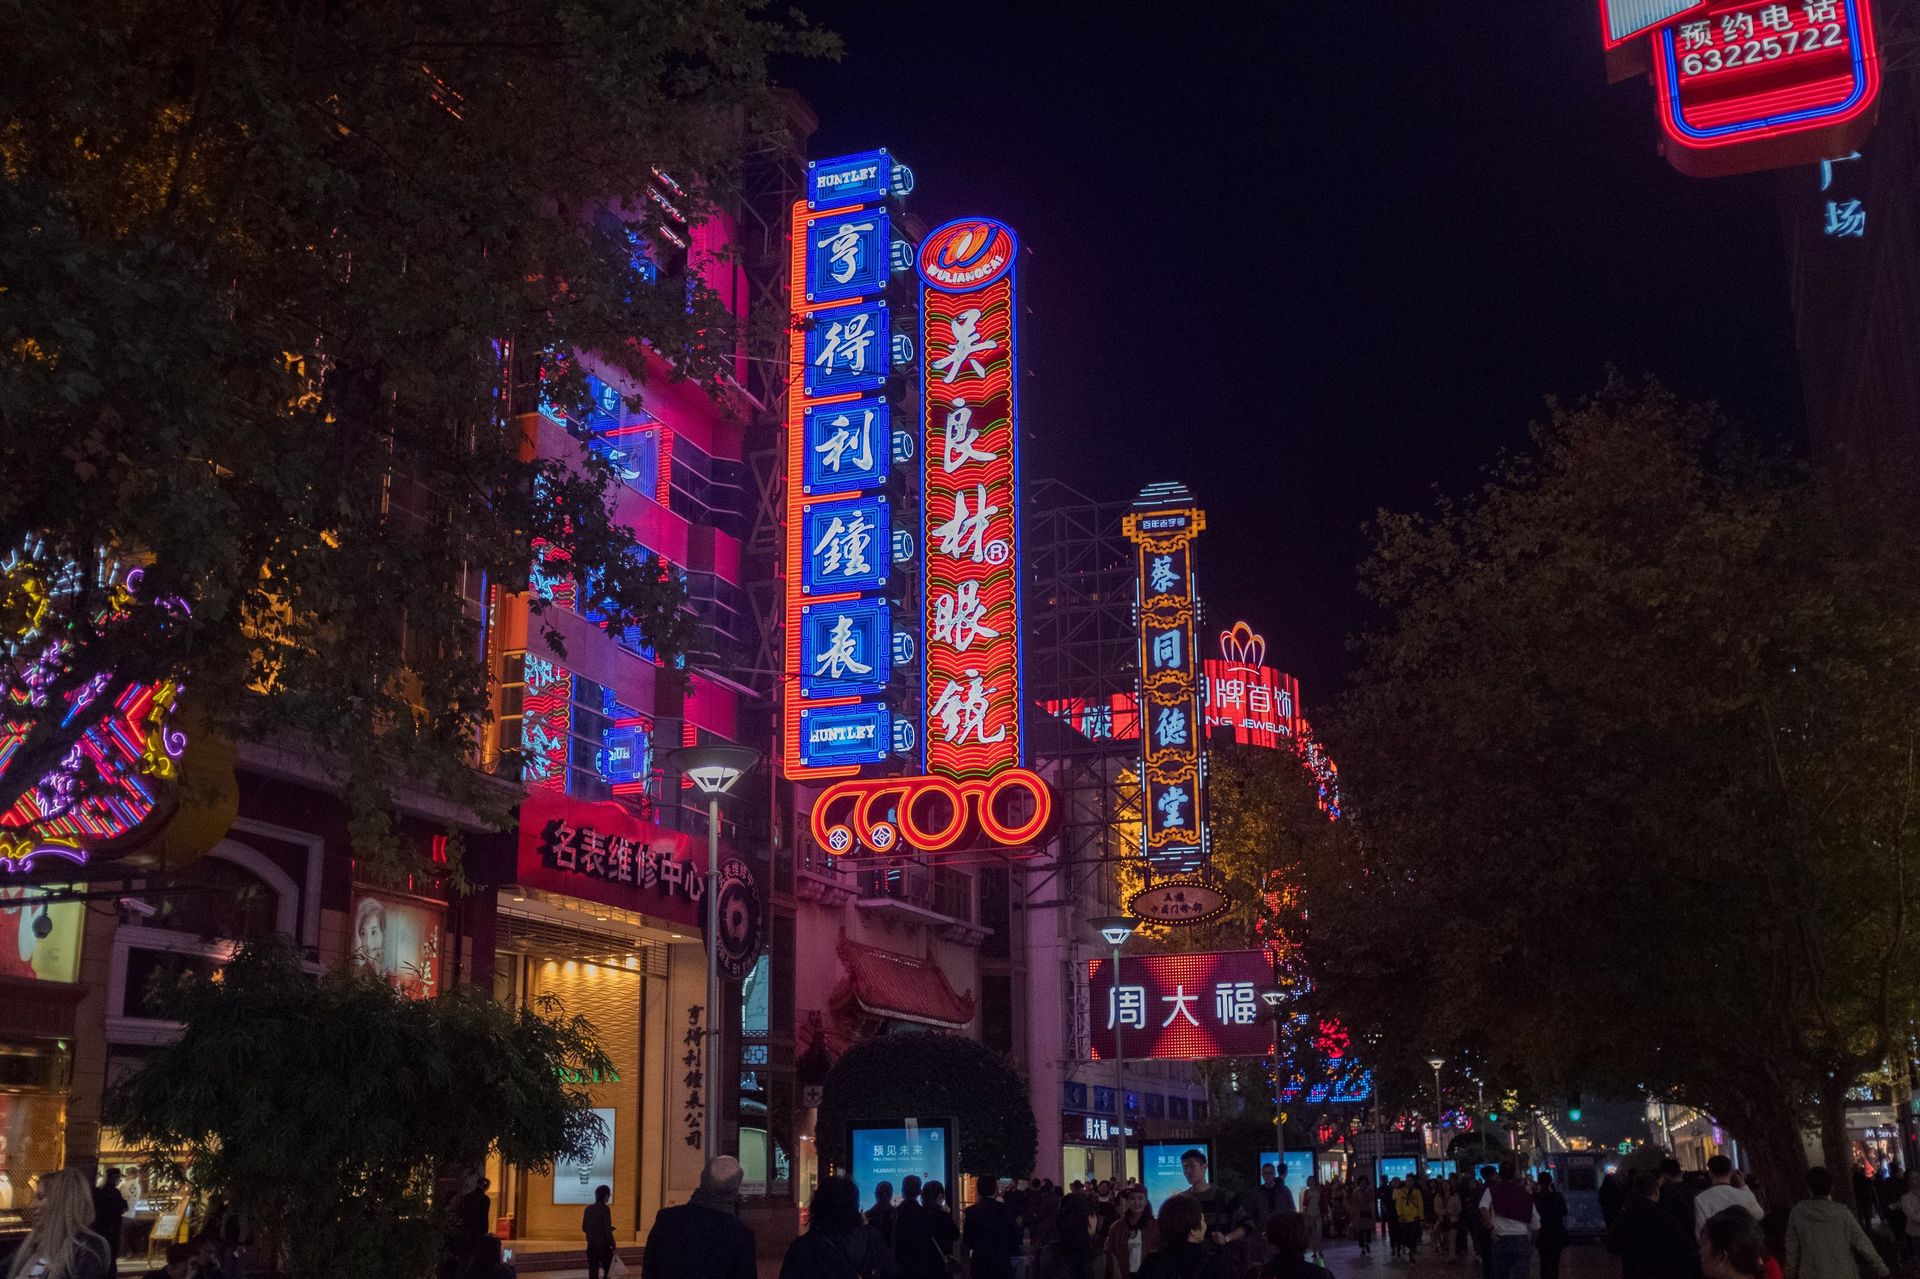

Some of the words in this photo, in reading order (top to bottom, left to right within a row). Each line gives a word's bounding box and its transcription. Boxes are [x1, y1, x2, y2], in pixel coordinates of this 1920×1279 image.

[1680, 0, 1838, 50] 预约电话
[1682, 23, 1843, 76] 63225722
[817, 166, 877, 188] HUNTLEY
[926, 255, 1005, 284] WULIANGCAI
[1150, 556, 1189, 827] 蔡同德堂
[1205, 676, 1292, 720] 牌首饰
[809, 724, 876, 742] HUNTLEY
[1238, 718, 1292, 737] JEWELRY
[553, 820, 705, 902] 名表维修中心
[1107, 982, 1257, 1030] 周大福
[1086, 1117, 1108, 1140] 周大福
[873, 1144, 923, 1157] 预见未来
